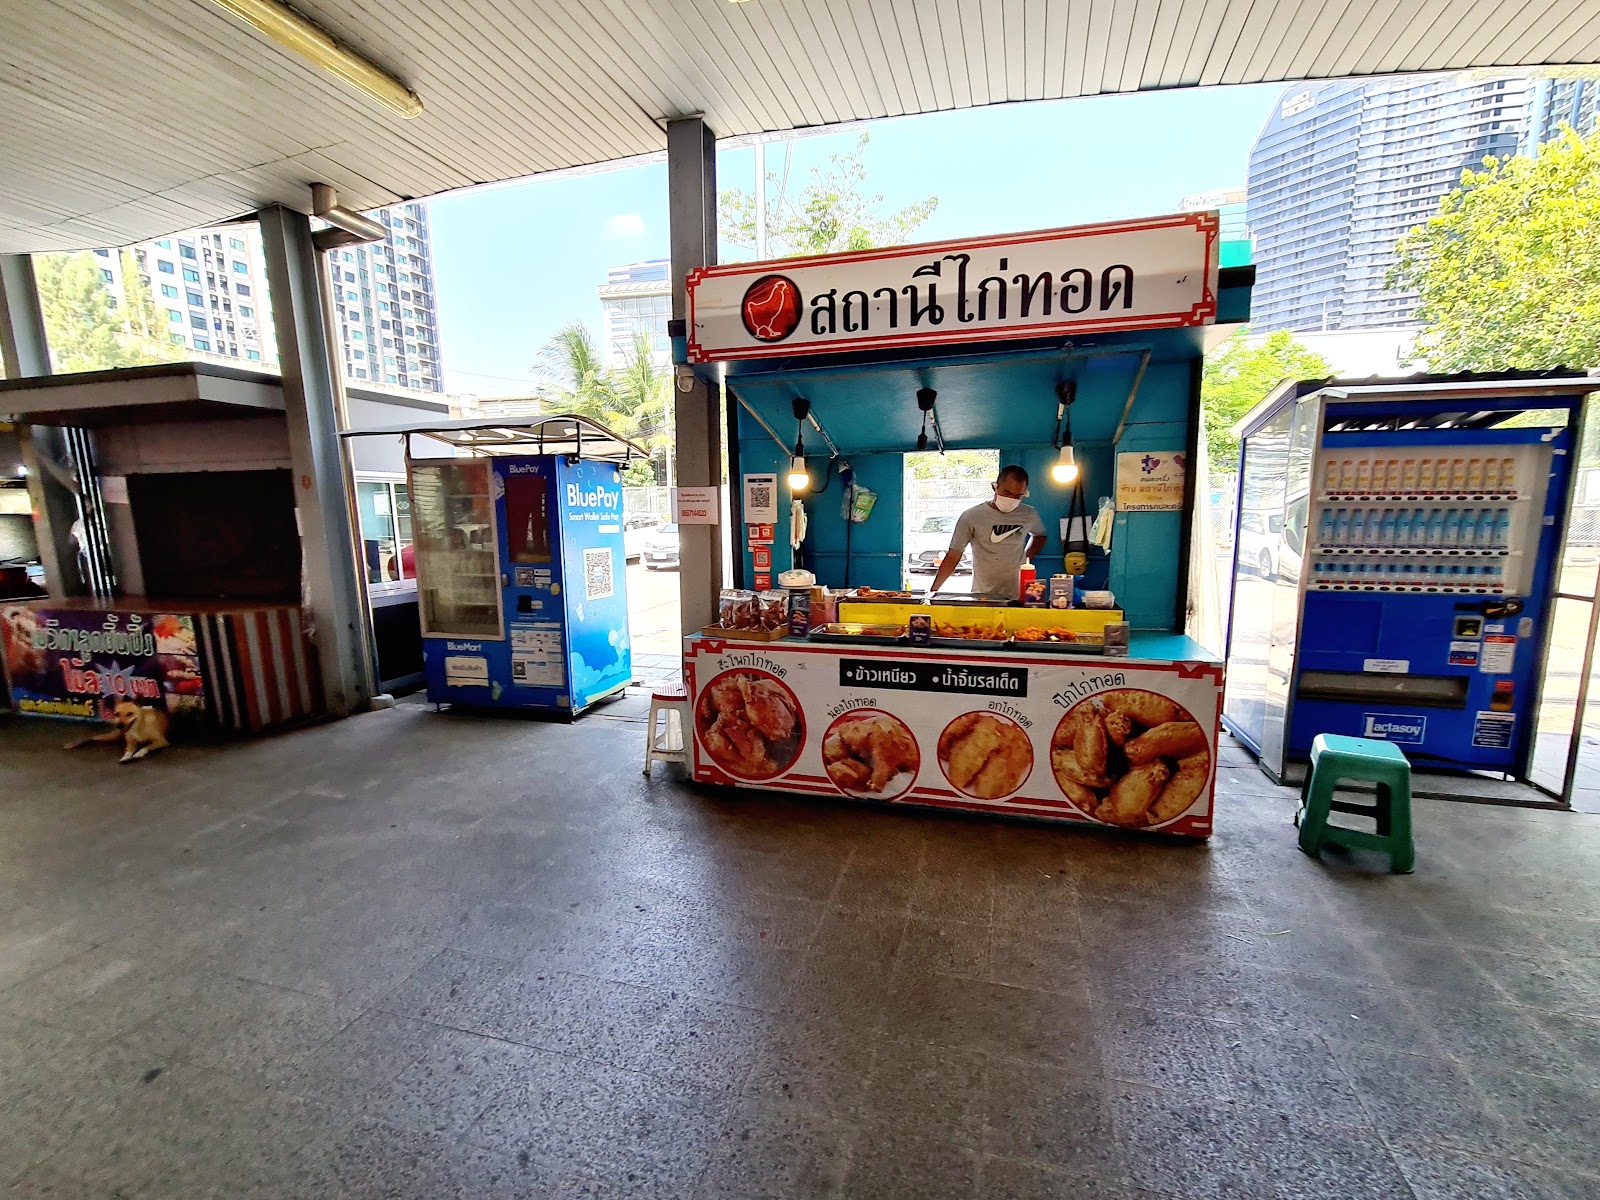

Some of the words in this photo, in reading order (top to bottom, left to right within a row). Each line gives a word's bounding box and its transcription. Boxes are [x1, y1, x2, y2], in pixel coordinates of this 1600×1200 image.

[810, 253, 1134, 336] สถานีไก่ทอด
[508, 464, 539, 474] BluePay
[567, 484, 619, 510] BluePay
[569, 512, 583, 521] Smart
[447, 642, 481, 652] BlueMart
[855, 666, 917, 684] ข้าวเหนียว
[942, 668, 1019, 690] น้ำจิ้มรสเด็ด
[1052, 671, 1126, 709] ปีกไก่ทอด
[827, 693, 877, 719] น่องไก่ทอด
[988, 700, 1033, 729] อกไก่ทอด
[1365, 716, 1422, 738] Lactasoy
